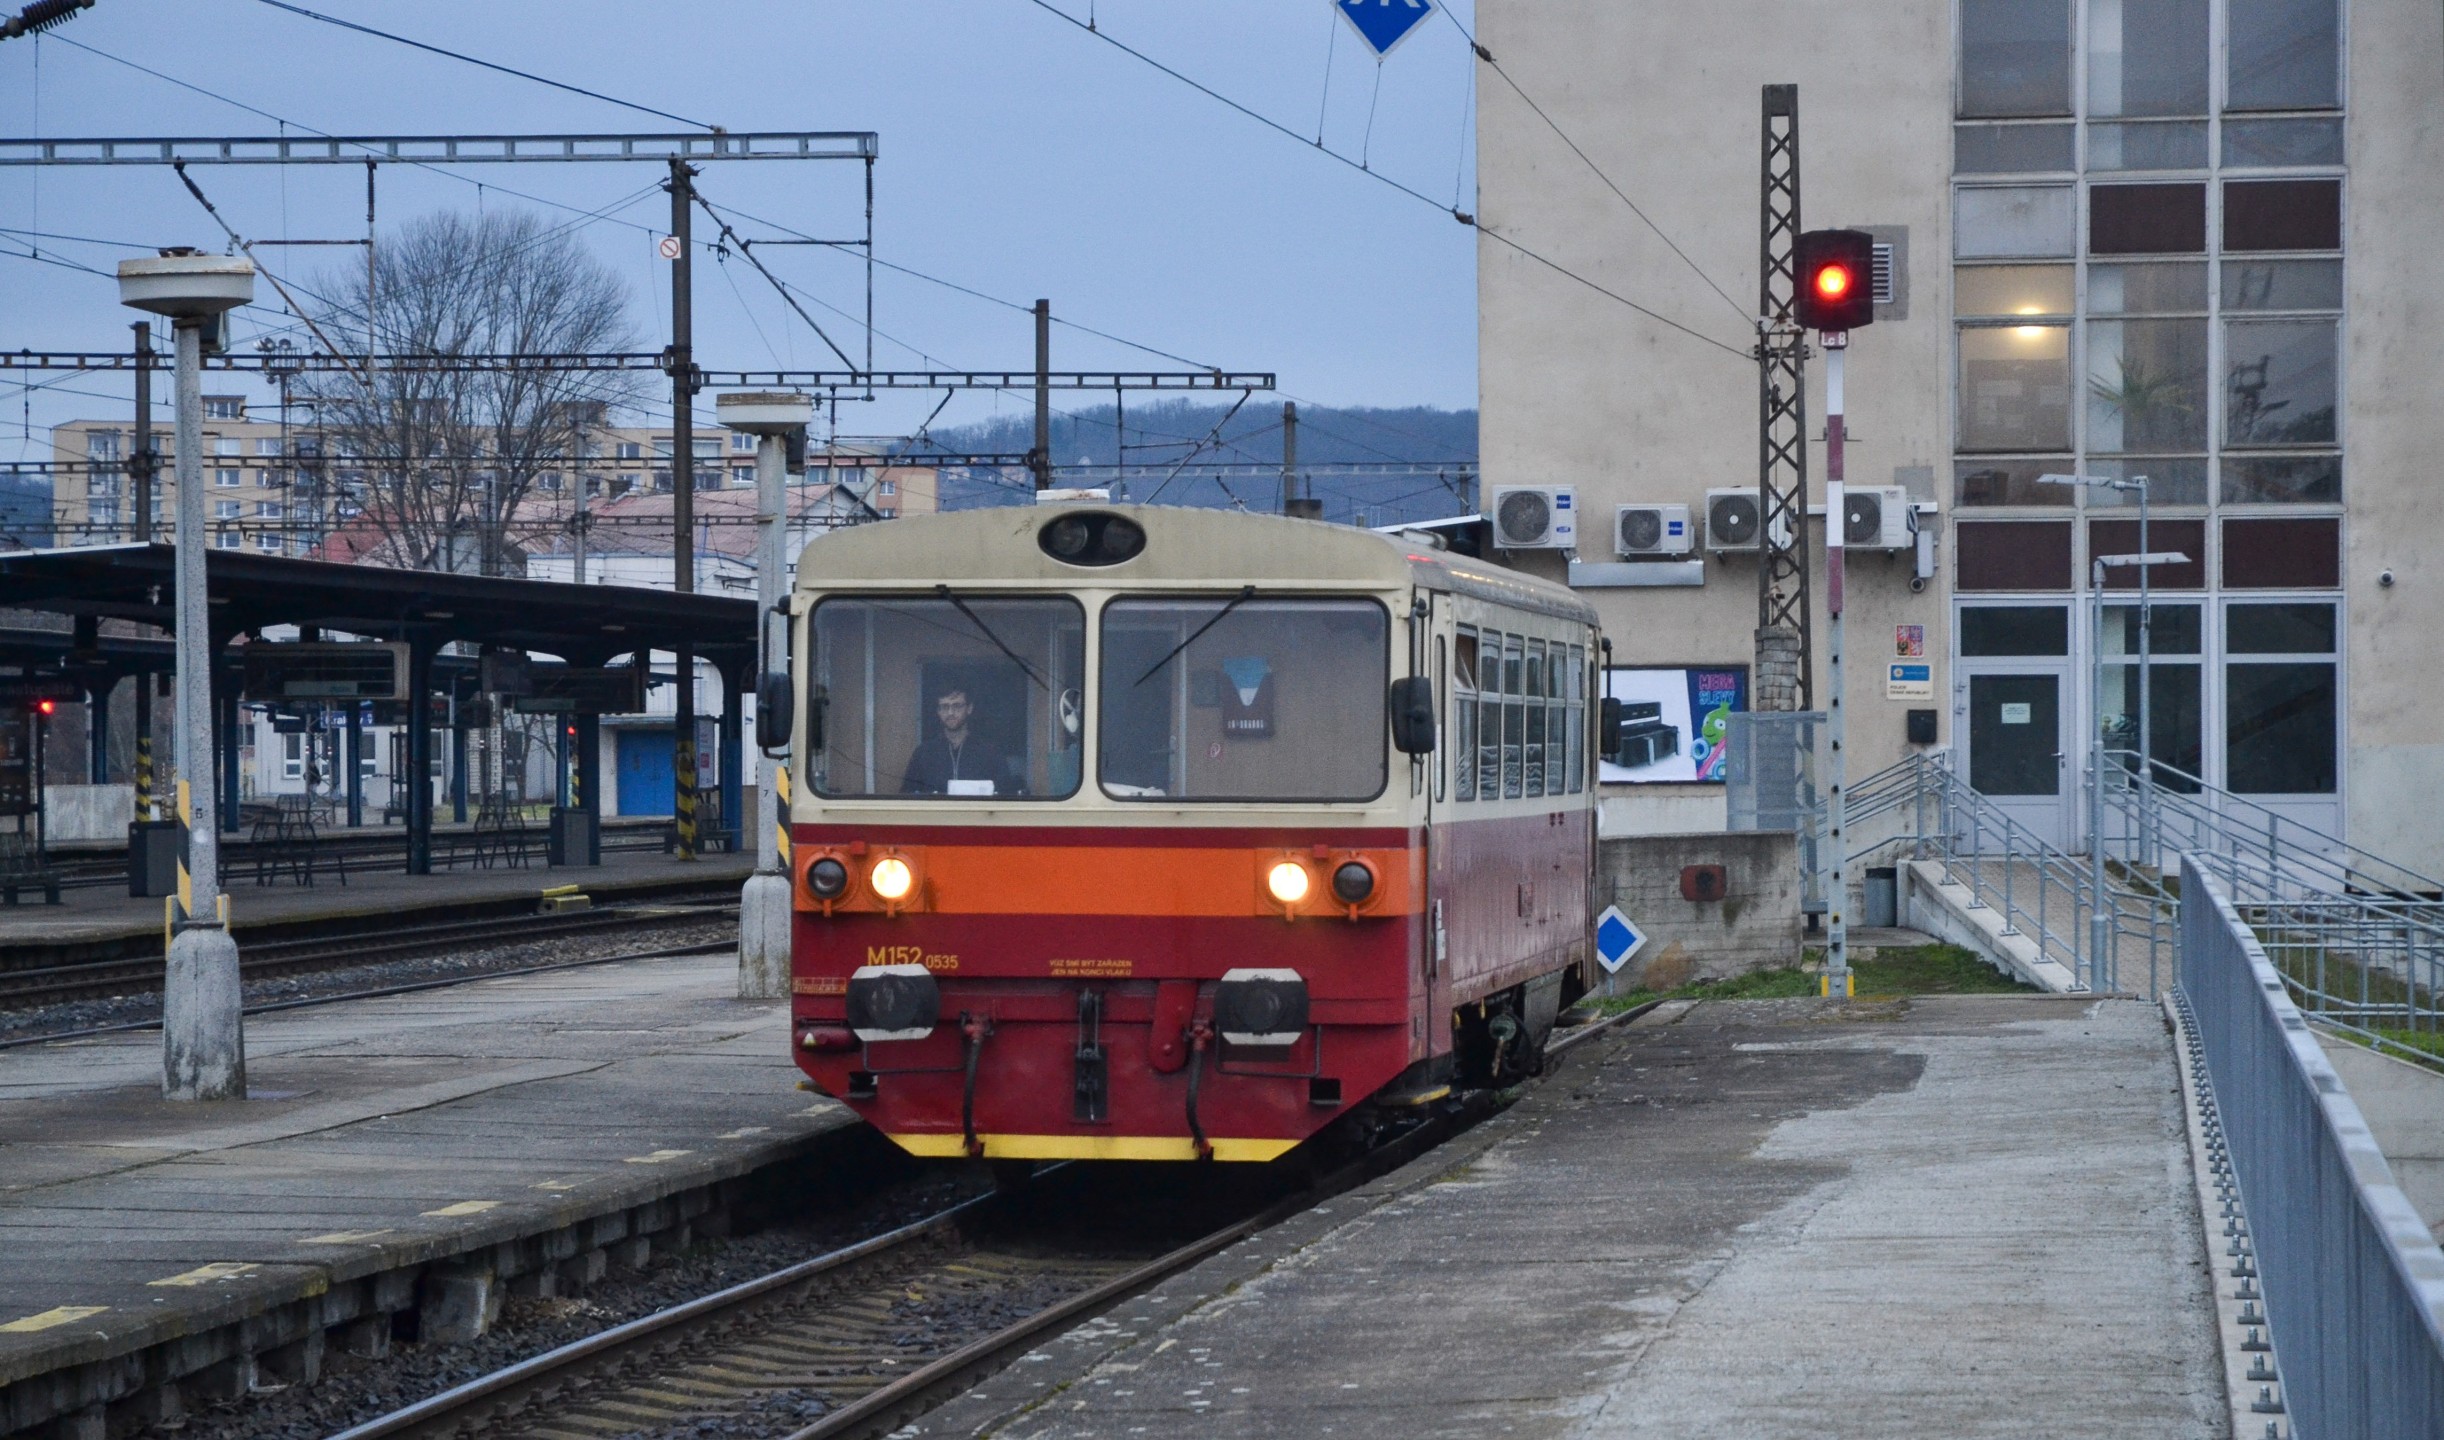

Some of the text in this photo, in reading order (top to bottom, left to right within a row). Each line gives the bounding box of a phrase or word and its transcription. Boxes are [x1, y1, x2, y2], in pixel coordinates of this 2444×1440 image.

[1821, 331, 1835, 346] Lc
[867, 946, 959, 969] M152 0535
